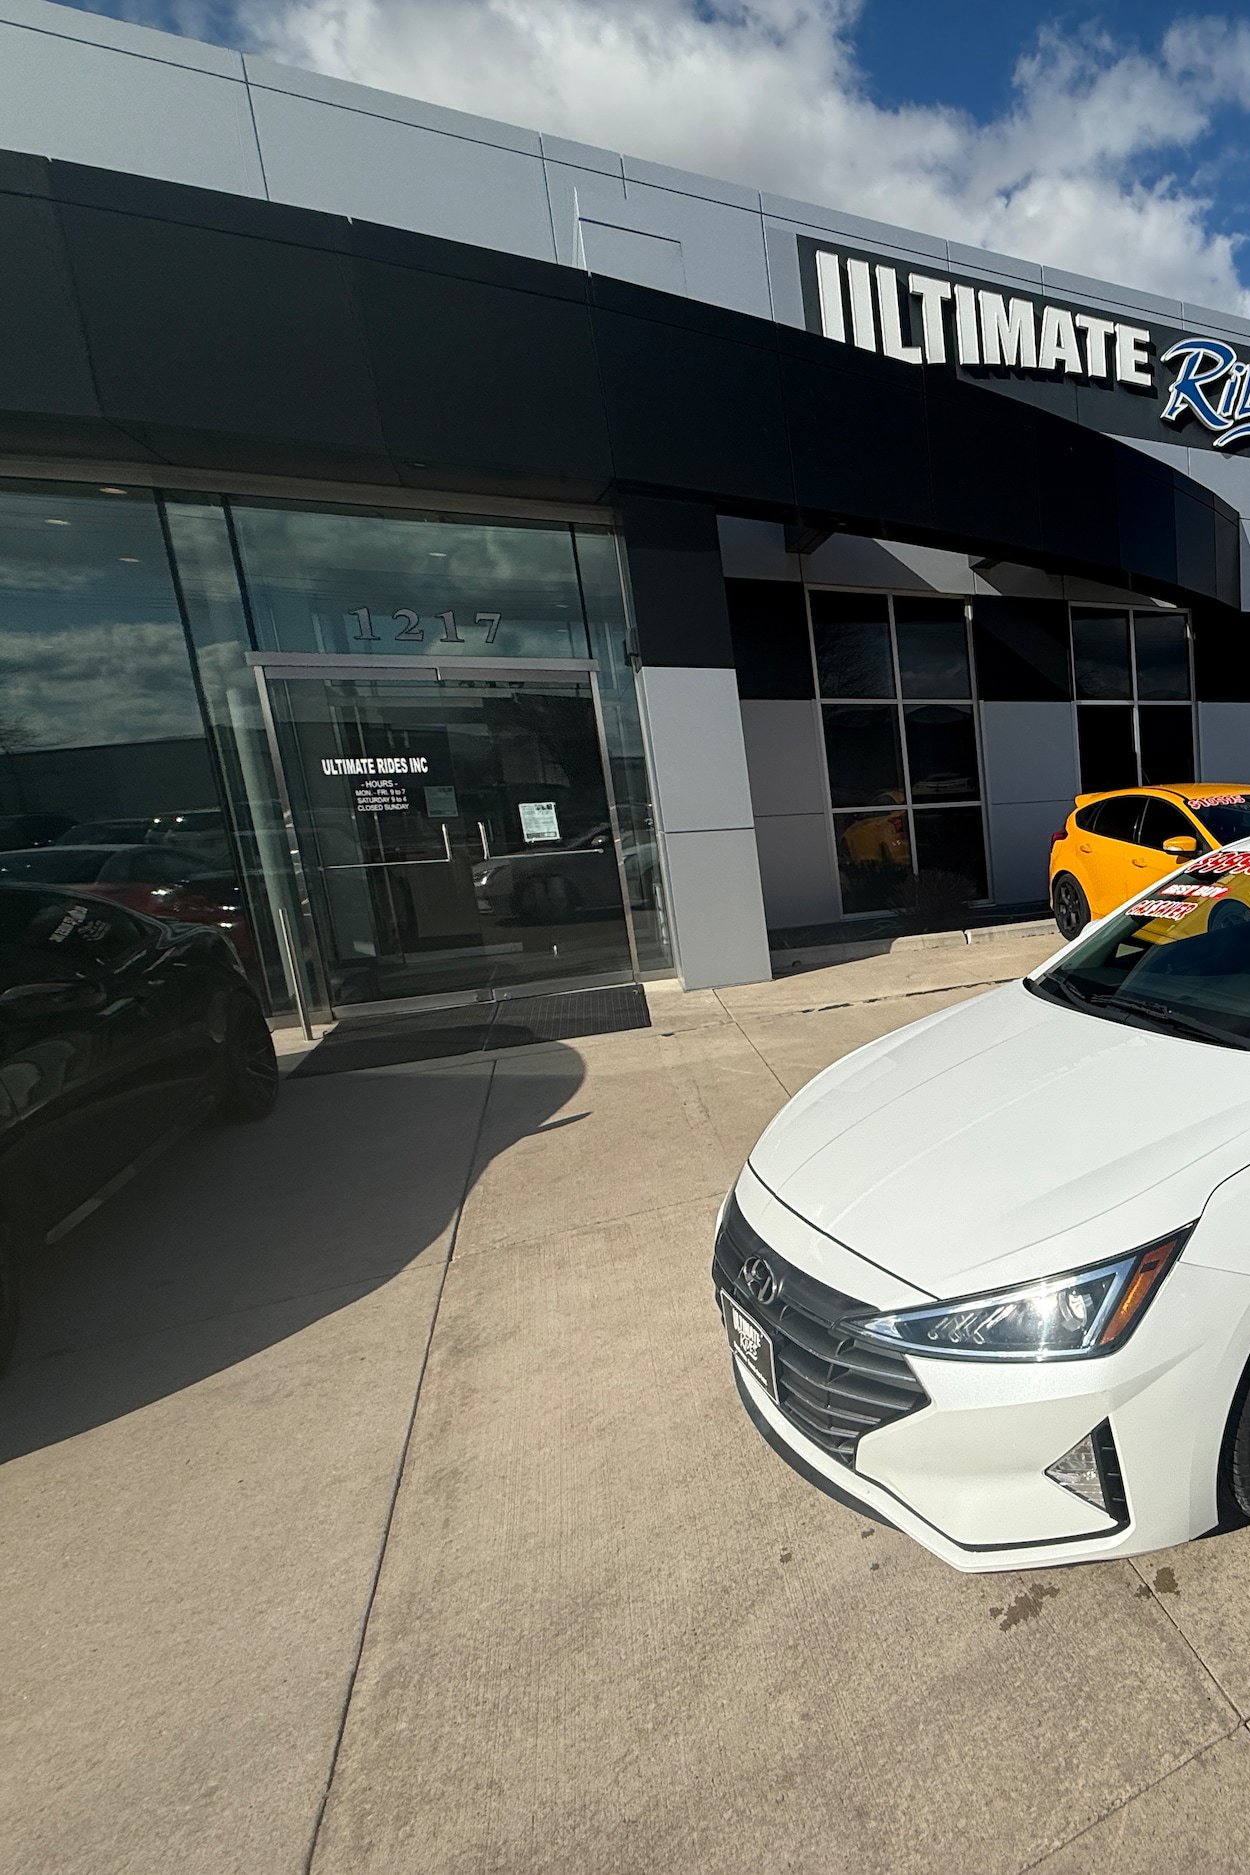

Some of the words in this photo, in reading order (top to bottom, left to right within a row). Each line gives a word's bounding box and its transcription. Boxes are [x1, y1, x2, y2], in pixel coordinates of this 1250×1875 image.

[816, 250, 1152, 387] ULTIMATE
[348, 606, 502, 644] 1217
[321, 758, 376, 776] ULTIMATE
[376, 757, 409, 775] RIDES
[409, 757, 429, 774] INC
[365, 779, 394, 788] HOURS
[357, 796, 390, 804] SATURDAY
[357, 804, 383, 812] CLOSED
[383, 803, 409, 811] SUNDAY
